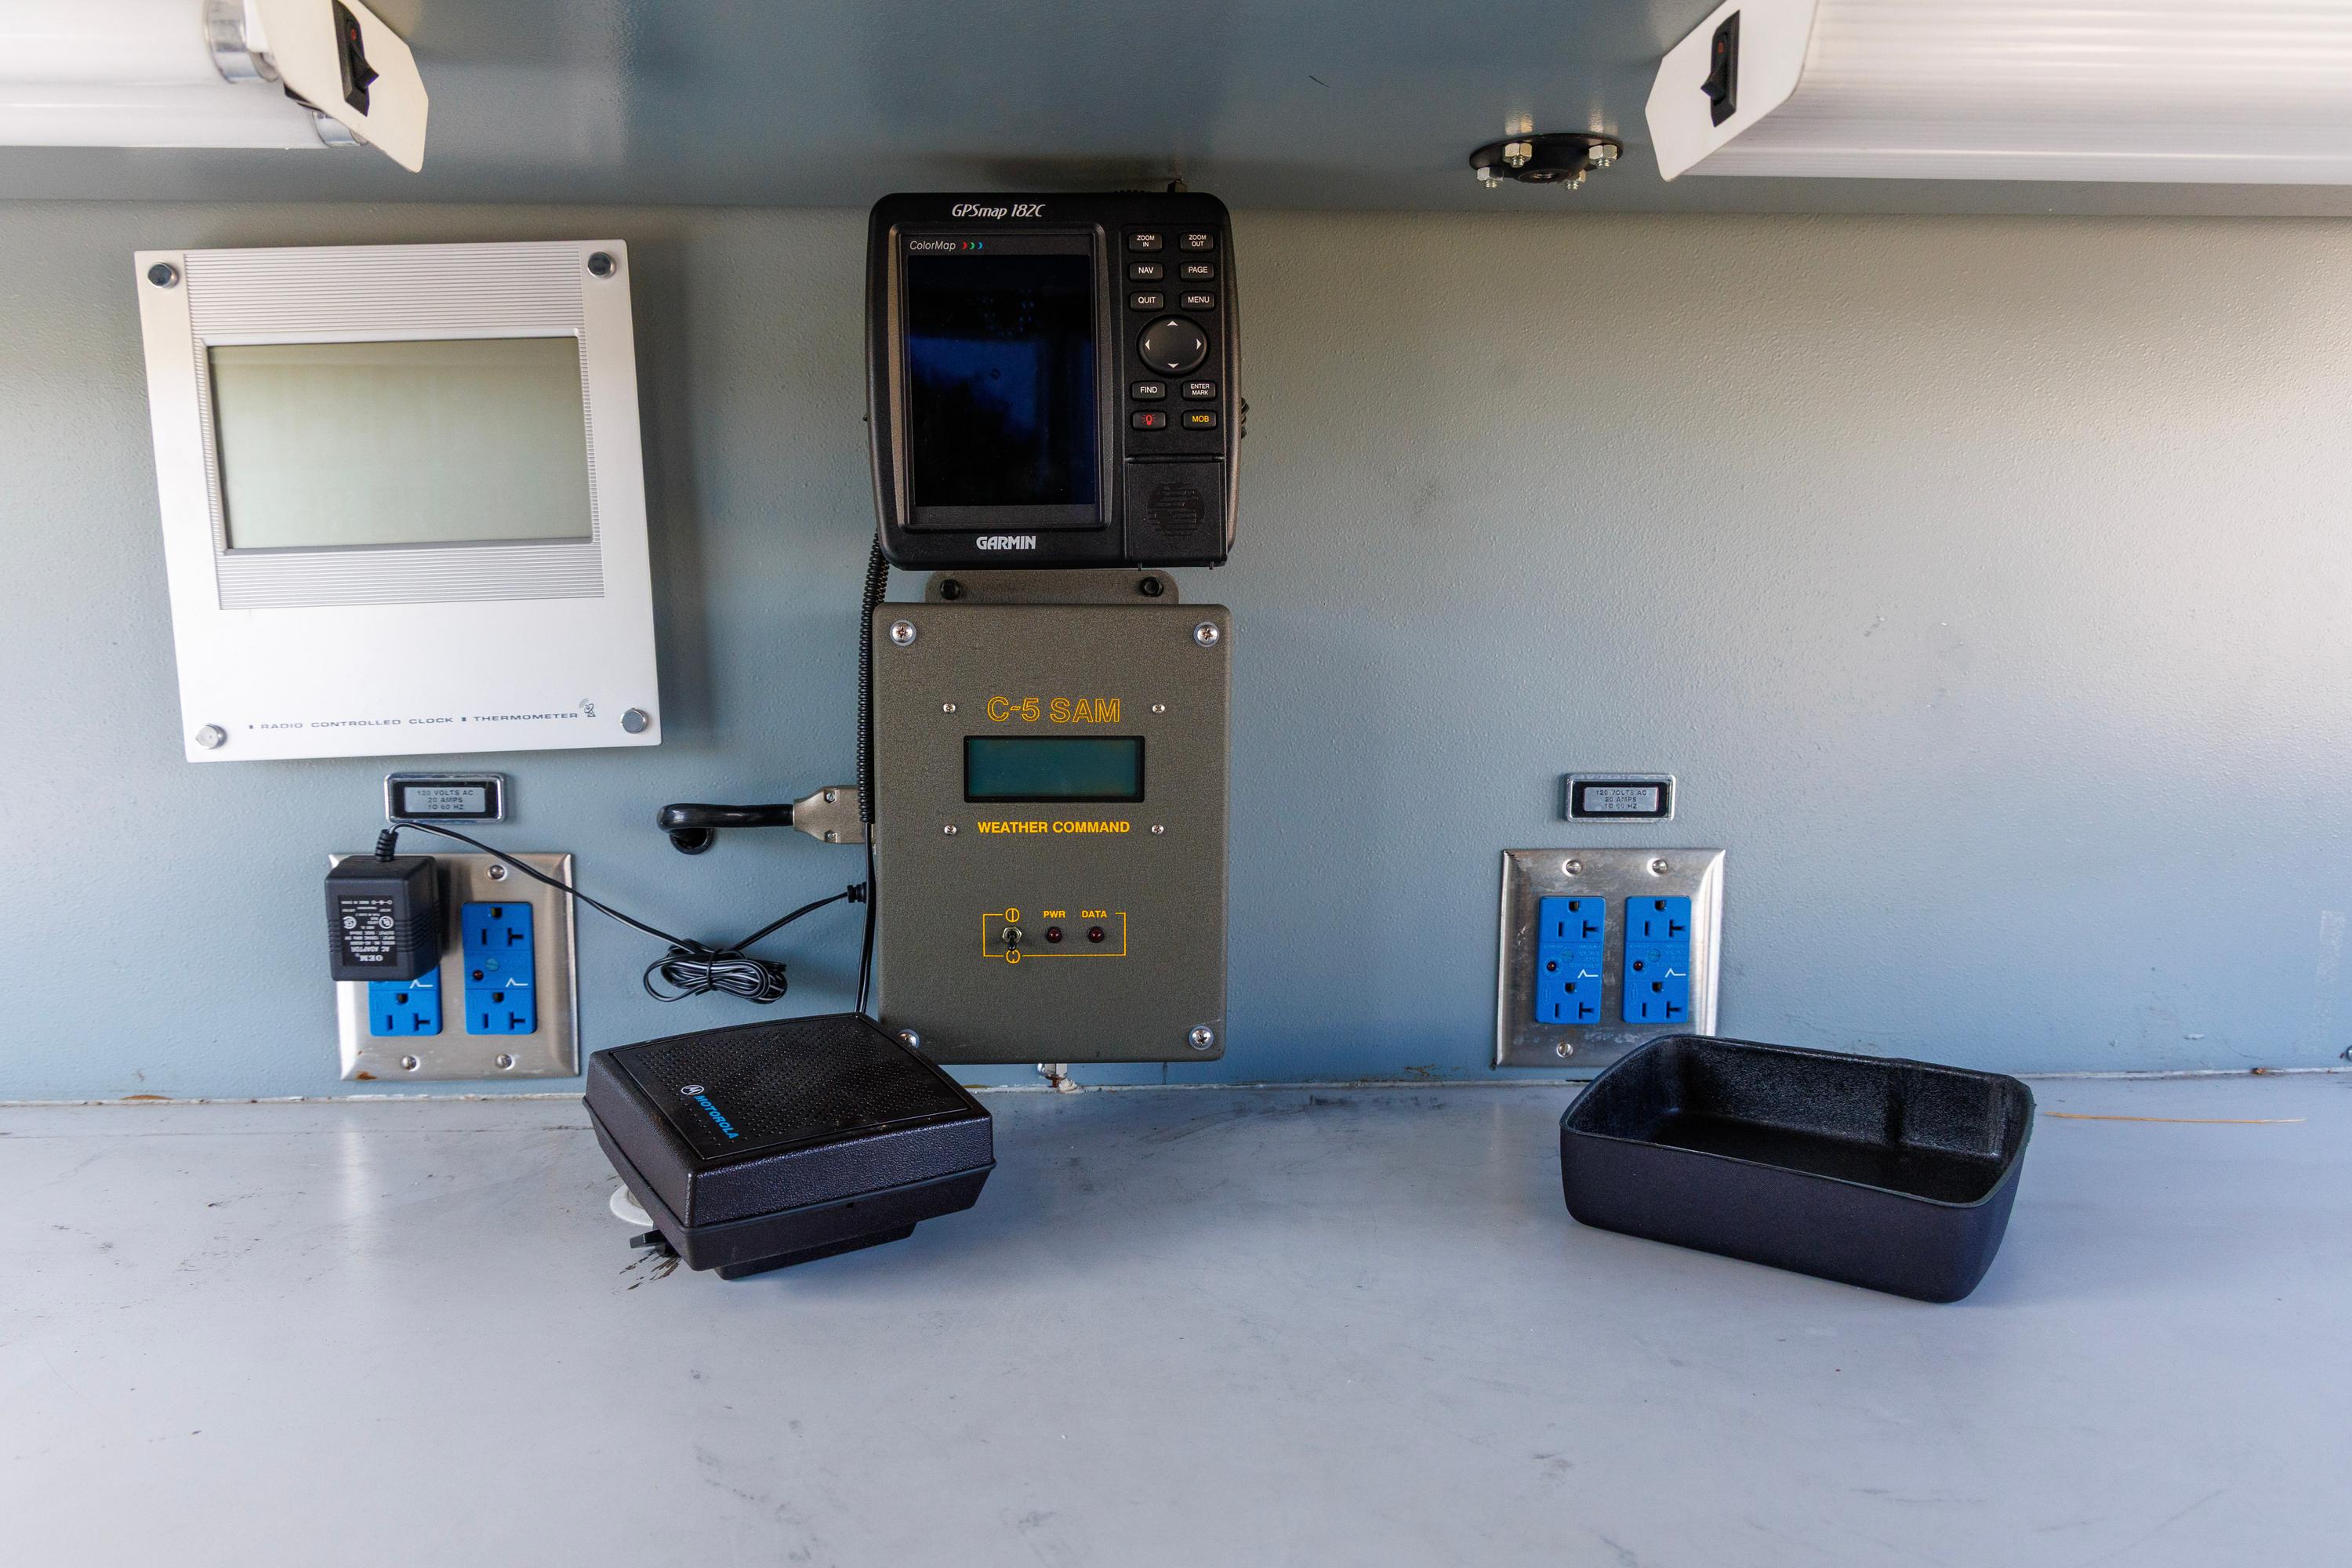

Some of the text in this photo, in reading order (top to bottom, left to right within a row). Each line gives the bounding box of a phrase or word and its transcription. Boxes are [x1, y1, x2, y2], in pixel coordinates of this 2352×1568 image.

[951, 204, 1046, 220] GPSmap 182C
[909, 240, 956, 252] ColorMap
[976, 535, 1036, 550] GARMIN
[987, 696, 1121, 723] C-5 SAM
[311, 718, 401, 728] CONTROLLED
[473, 712, 579, 721] THERMOMETER
[978, 821, 1131, 833] WEATHER COMMAND
[694, 1095, 739, 1139] MOTOROLA
